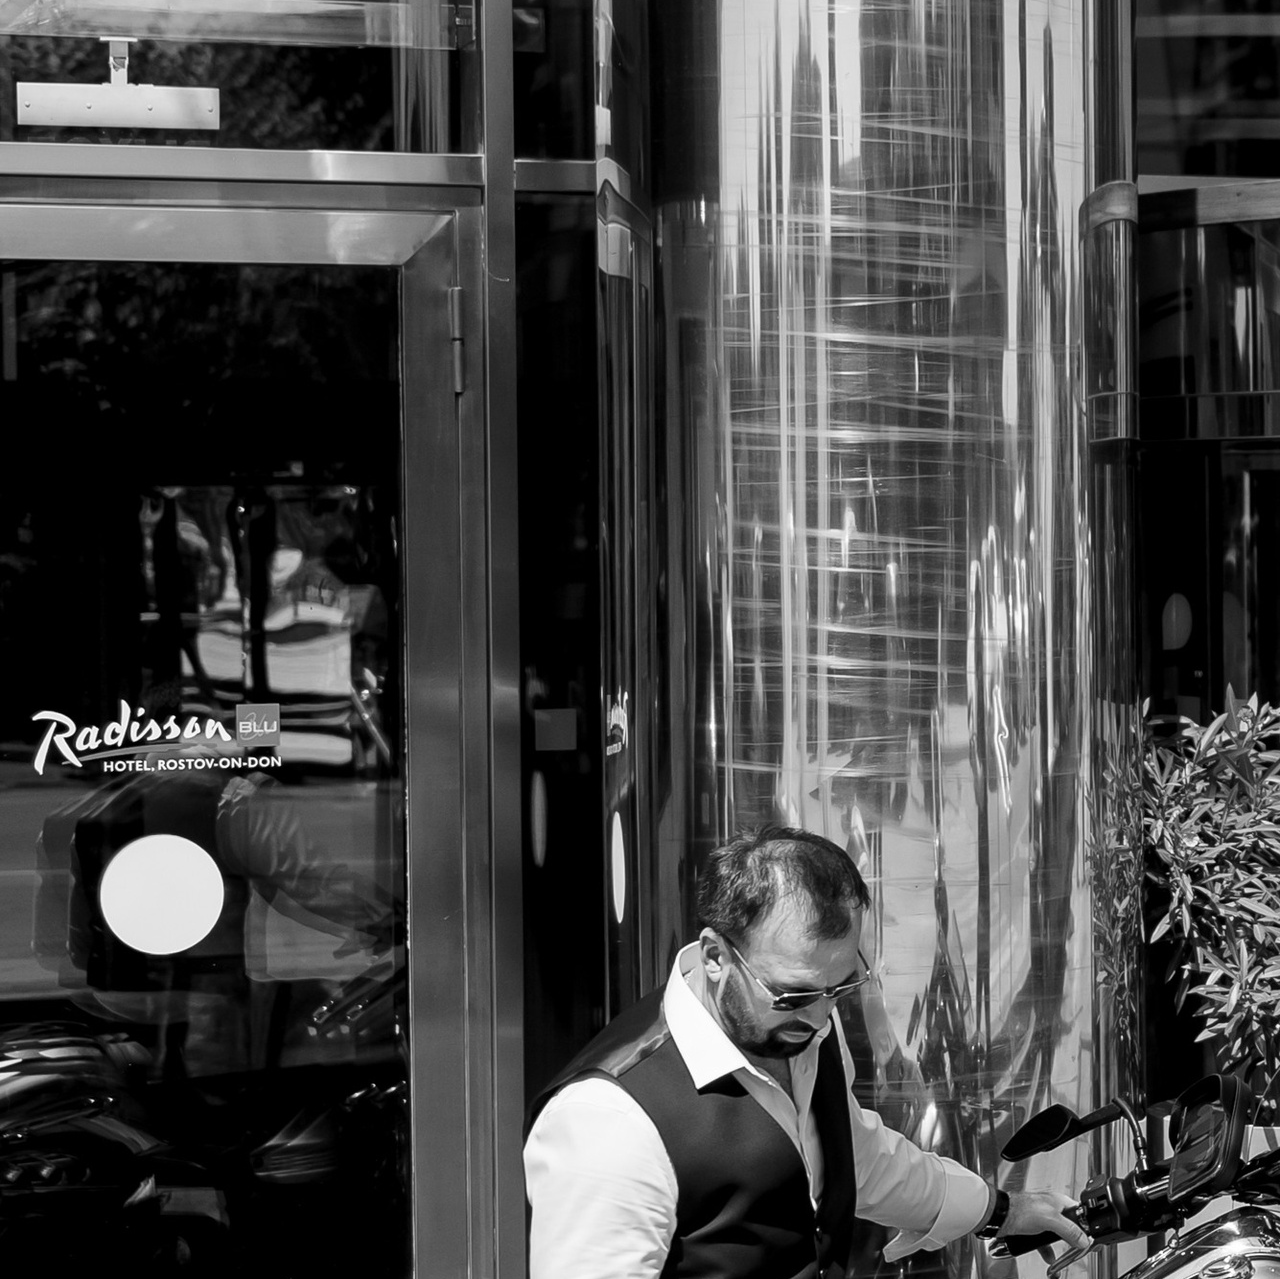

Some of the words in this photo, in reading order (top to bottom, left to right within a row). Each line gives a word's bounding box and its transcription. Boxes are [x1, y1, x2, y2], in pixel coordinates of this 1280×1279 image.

[32, 699, 232, 775] Radisson
[239, 720, 277, 733] BLU
[104, 760, 155, 772] HOTEL,
[157, 756, 282, 771] ROSTOV-ON-DON
